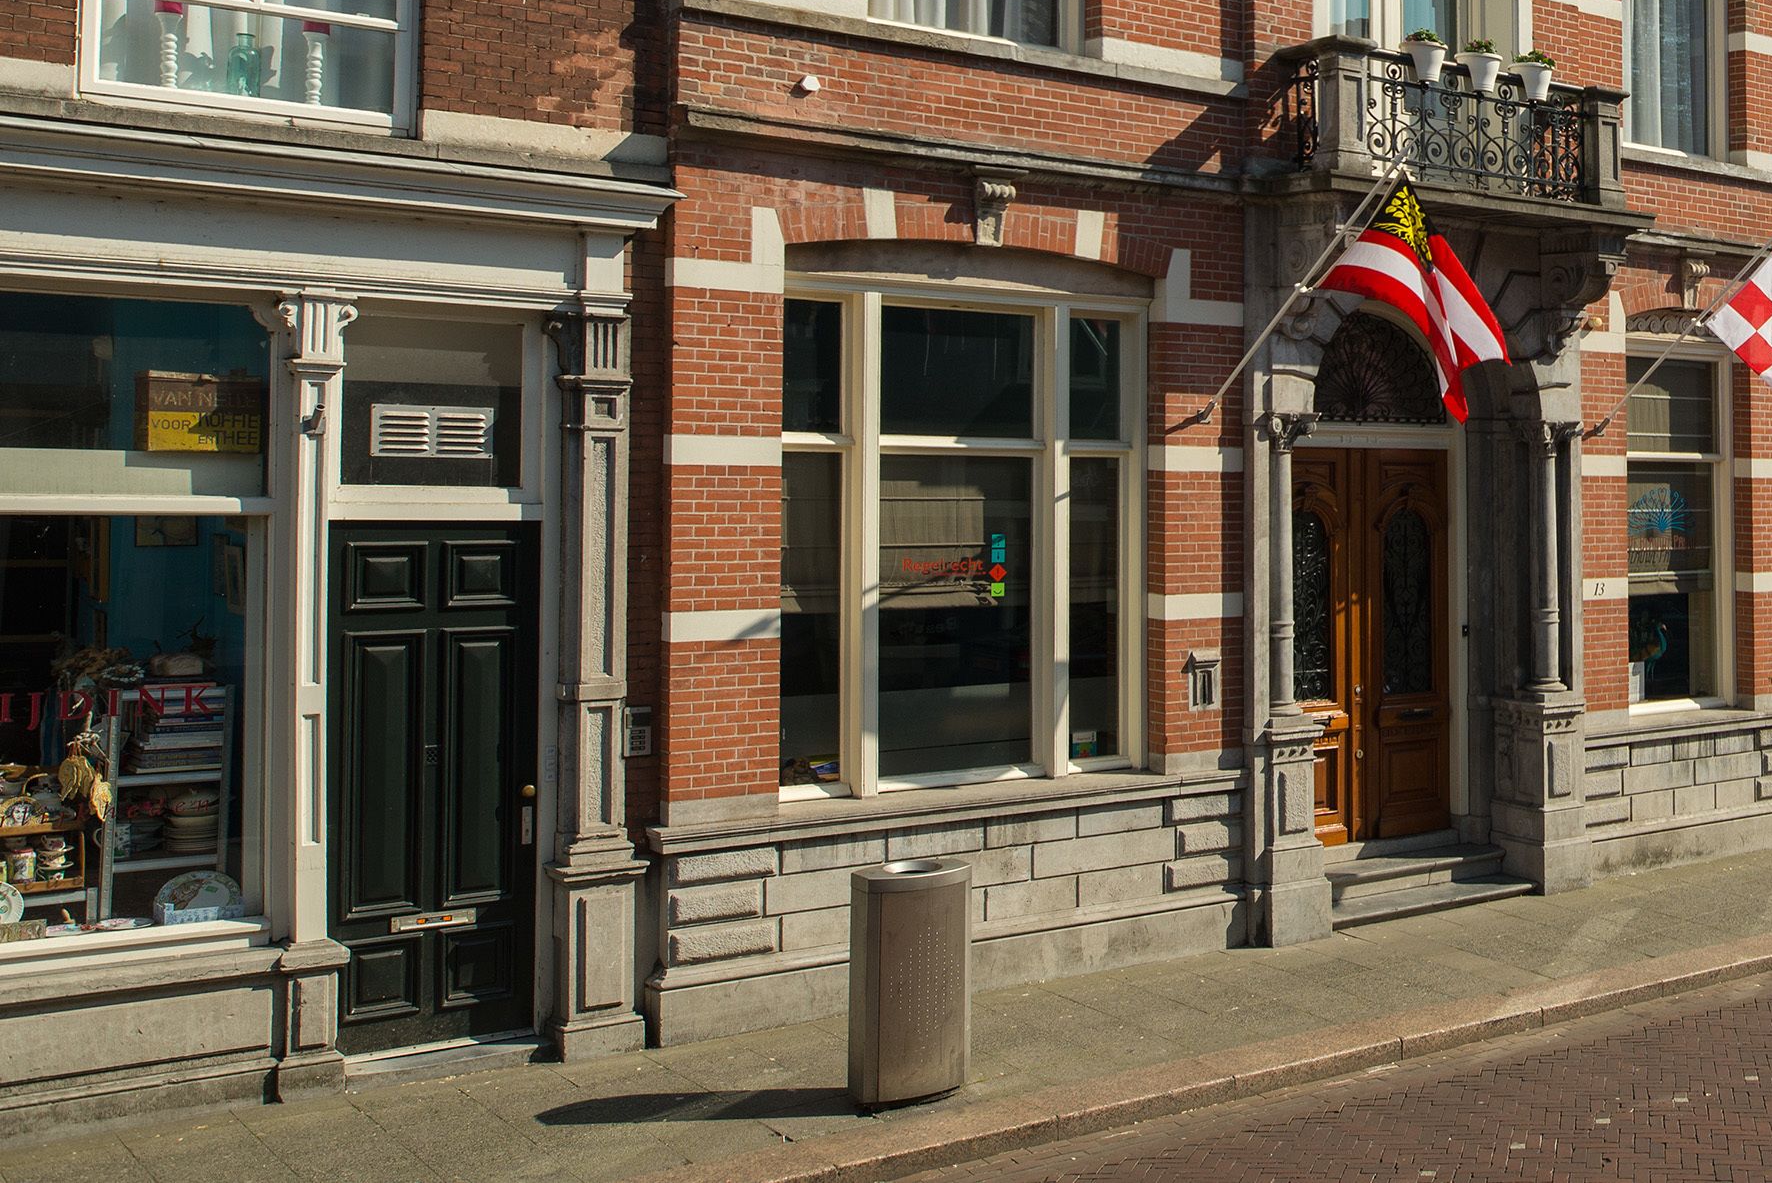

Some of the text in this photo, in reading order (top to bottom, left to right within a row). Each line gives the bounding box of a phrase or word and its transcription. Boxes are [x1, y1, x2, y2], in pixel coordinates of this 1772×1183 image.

[153, 389, 192, 406] VAN
[151, 412, 258, 431] VOOR KOFFIE
[216, 430, 258, 446] THEE
[901, 557, 983, 574] Regelrecht
[1593, 582, 1606, 597] 13
[0, 684, 214, 731] IJDINK
